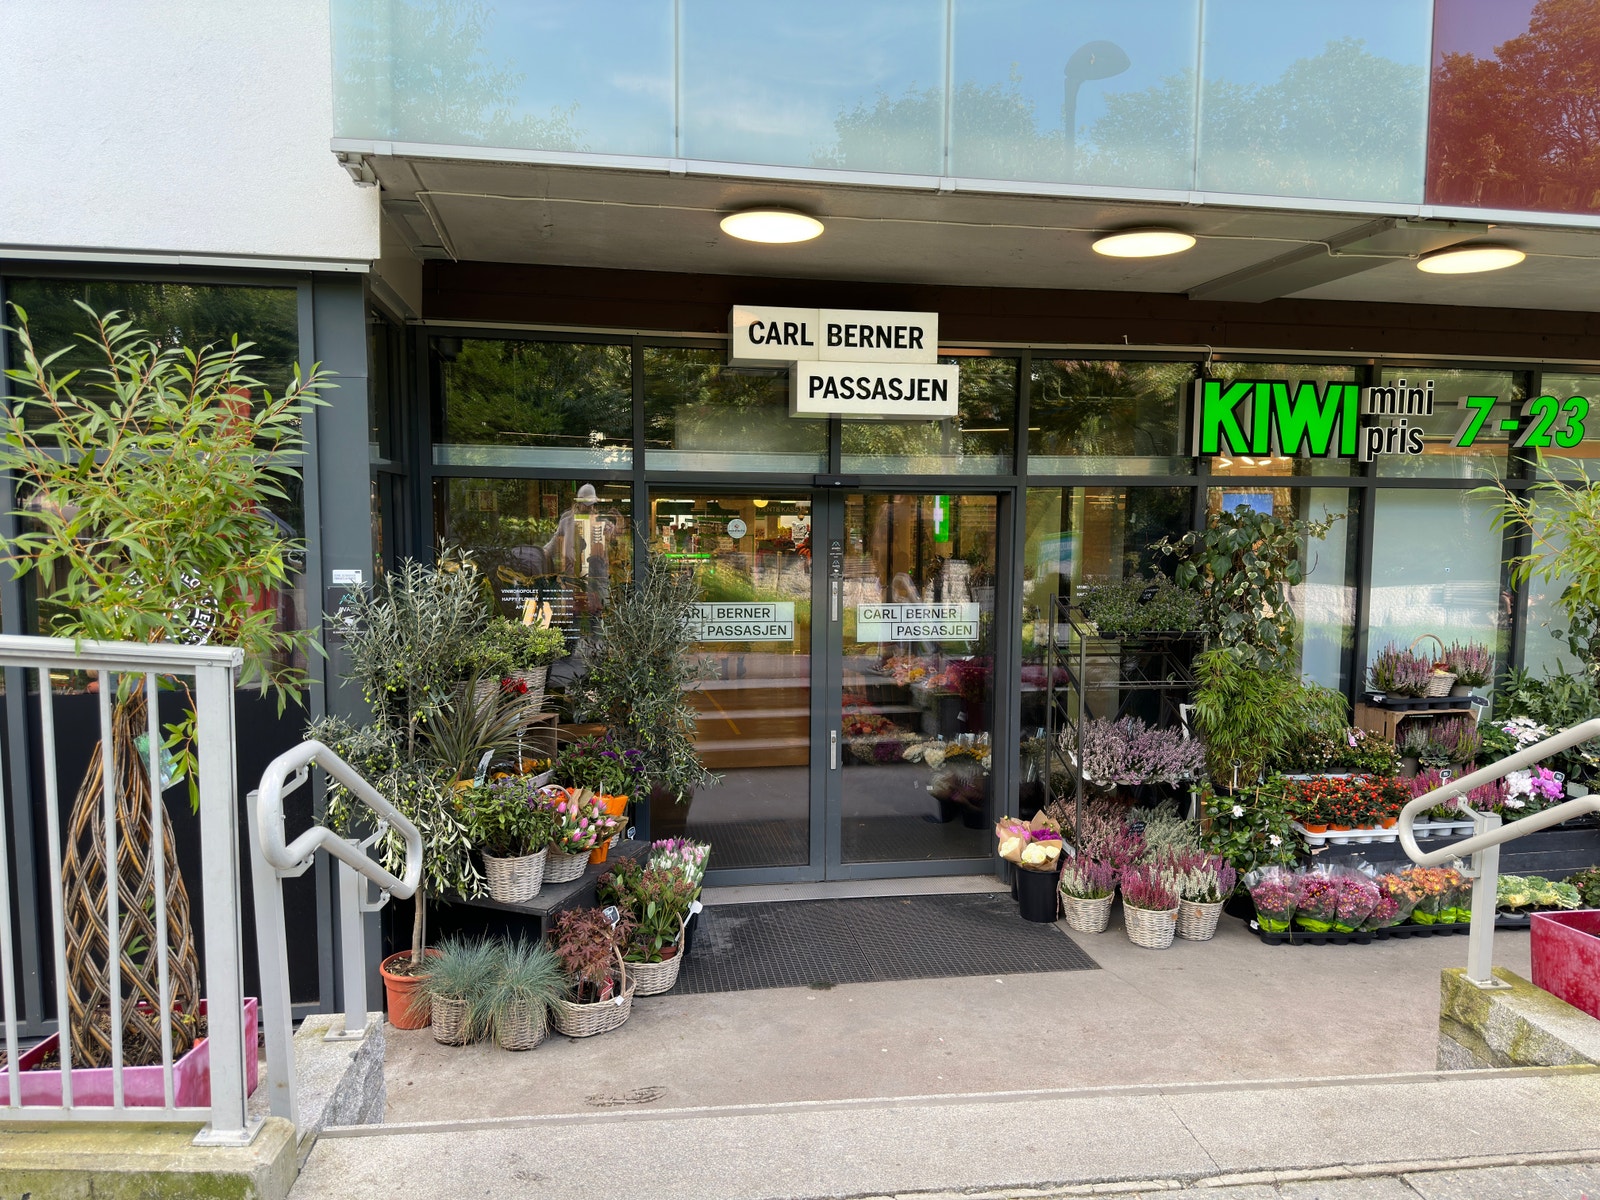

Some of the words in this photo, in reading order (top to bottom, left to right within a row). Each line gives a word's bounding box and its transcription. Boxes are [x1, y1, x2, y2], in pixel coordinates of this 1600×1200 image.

[749, 320, 814, 346] CARL
[827, 323, 924, 349] BERNER
[808, 375, 948, 402] PASSASJEN
[1368, 379, 1435, 416] mini
[1201, 379, 1361, 459] KIWI
[1365, 419, 1425, 462] pris
[682, 608, 707, 620] ARL
[716, 607, 771, 619] BERNER
[863, 608, 898, 620] CARL
[905, 608, 957, 620] BERNER
[707, 625, 787, 637] PASSASJEN
[896, 625, 973, 637] PASSASJEN
